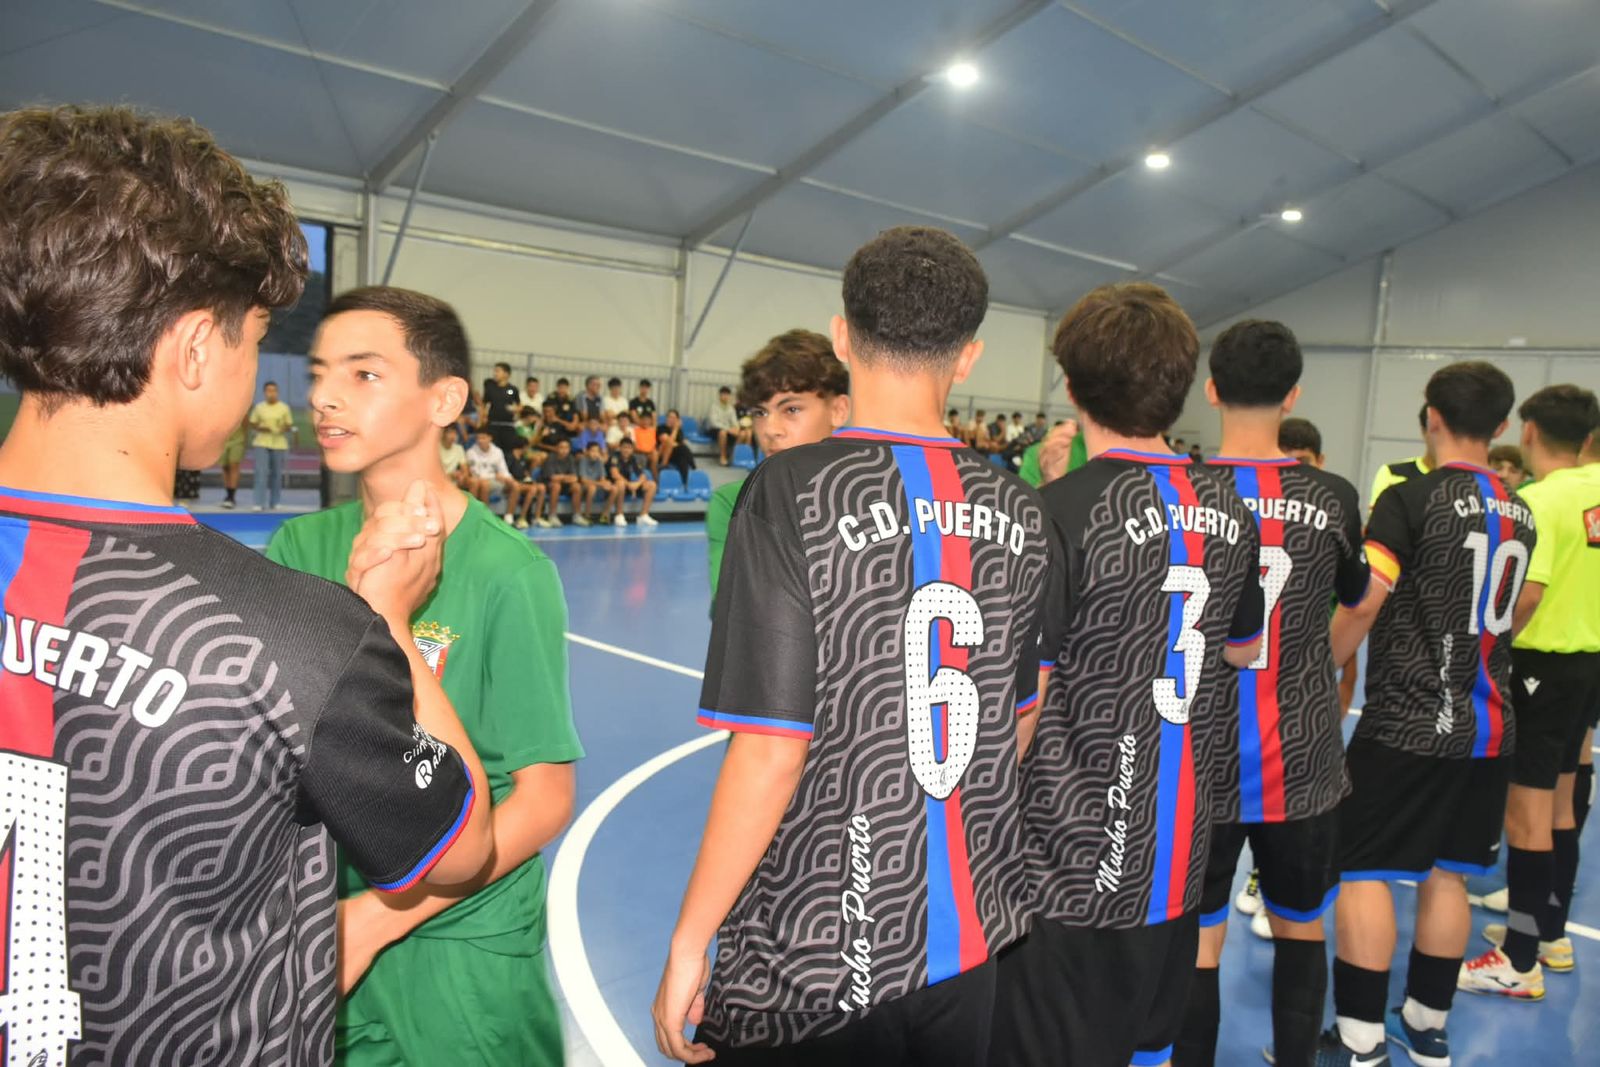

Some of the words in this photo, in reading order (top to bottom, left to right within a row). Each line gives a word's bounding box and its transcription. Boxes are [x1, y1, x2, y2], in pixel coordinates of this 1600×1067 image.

[837, 500, 911, 552] C.D.
[914, 498, 1025, 556] PUERTO
[1125, 506, 1168, 546] C.D.
[1168, 504, 1240, 546] PUERTO
[1453, 495, 1485, 518] C.D.
[1485, 497, 1535, 530] PUERTO
[1462, 531, 1528, 636] 10
[0, 612, 188, 729] UERTO
[1152, 565, 1211, 724] 3
[904, 581, 985, 800] 6
[1107, 734, 1137, 810] Puerto
[842, 814, 875, 923] Puerto
[1095, 820, 1128, 893] Mucho
